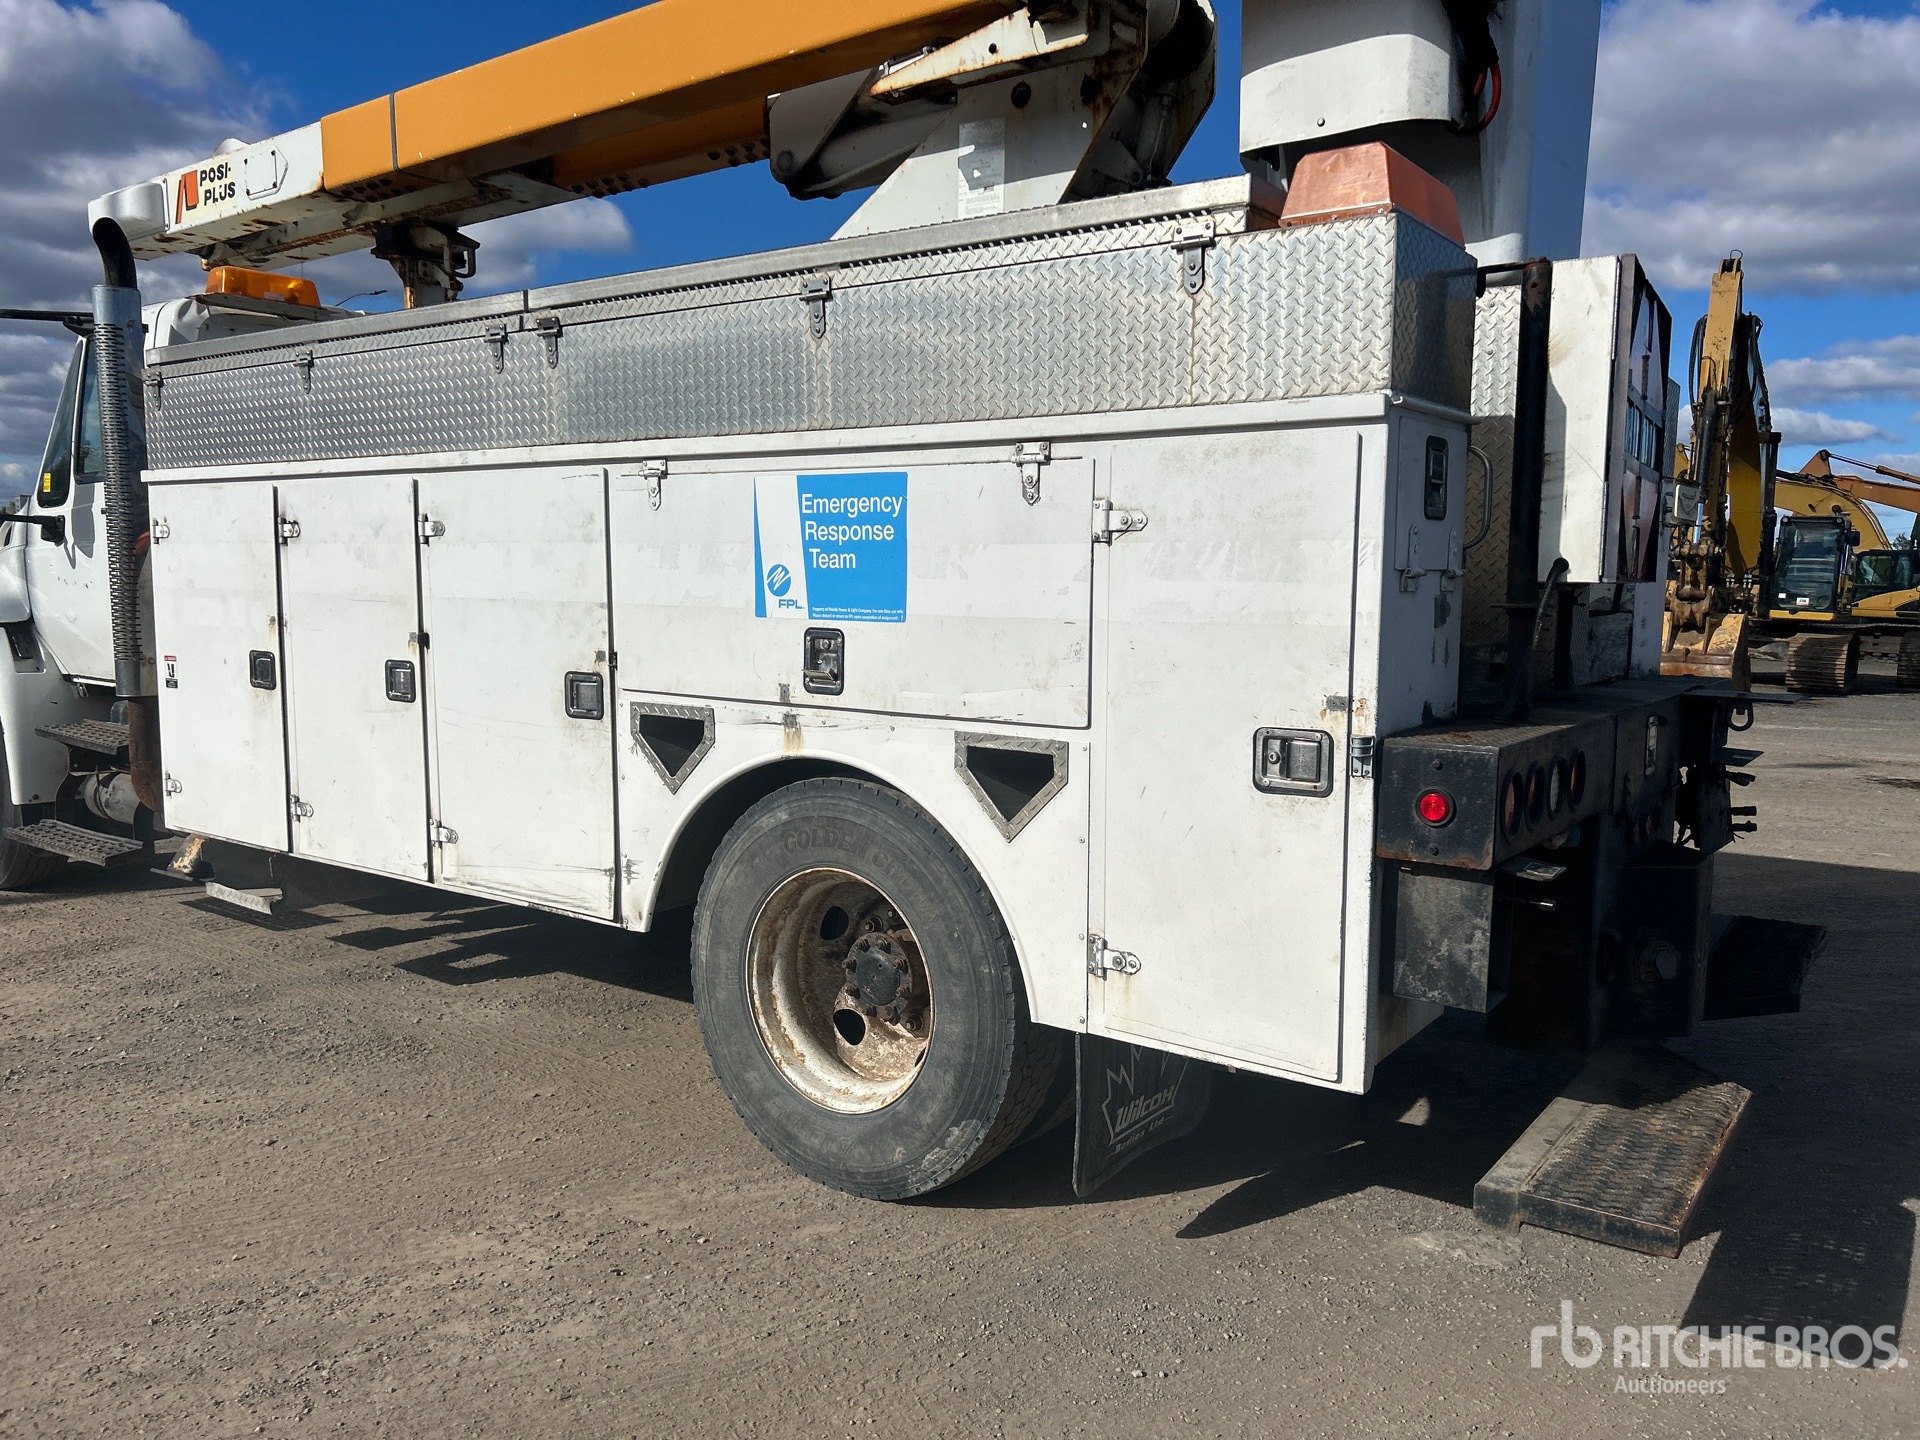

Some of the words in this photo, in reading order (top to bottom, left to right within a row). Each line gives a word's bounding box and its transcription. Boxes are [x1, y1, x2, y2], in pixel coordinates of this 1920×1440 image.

[204, 182, 236, 206] PLUS
[802, 493, 903, 518] Emergency
[805, 521, 894, 545] Response
[809, 548, 856, 569] Team
[778, 599, 803, 609] FPL
